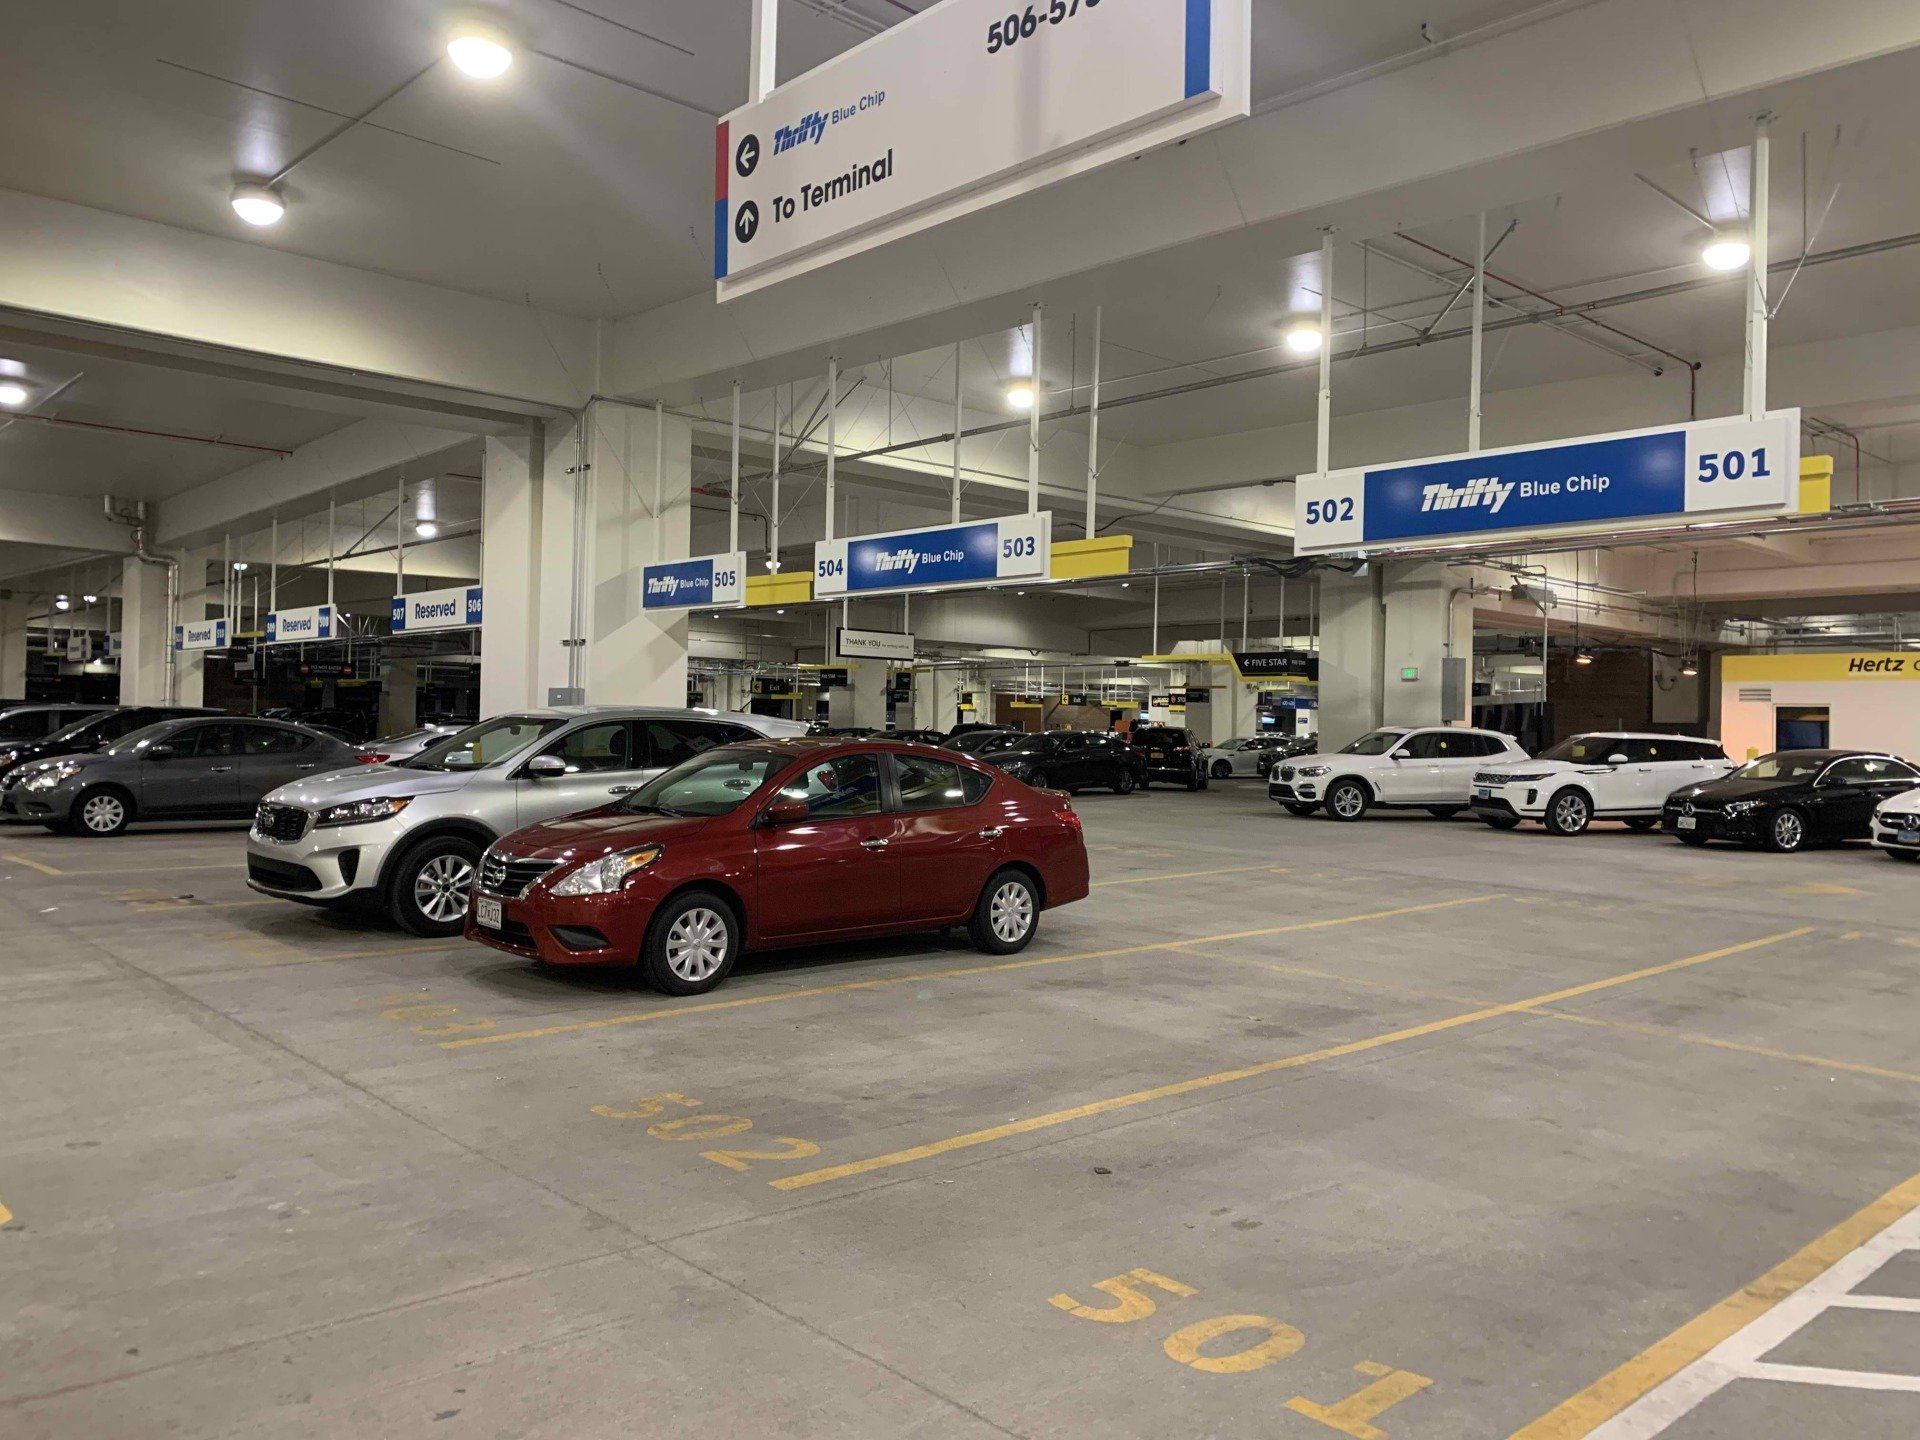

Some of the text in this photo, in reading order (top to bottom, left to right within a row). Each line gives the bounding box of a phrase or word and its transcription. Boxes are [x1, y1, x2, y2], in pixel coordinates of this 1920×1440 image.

[987, 0, 1101, 54] 506-57
[773, 91, 885, 155] Thrifty Blue Chip
[773, 148, 893, 223] To Terminal
[1698, 448, 1770, 483] 501
[1420, 474, 1610, 514] Thrifty Blue Chip
[1306, 497, 1354, 525] 502
[1002, 536, 1035, 558] 503
[818, 558, 844, 577] 504
[875, 549, 964, 574] Thrifty Blue Chip
[648, 576, 709, 596] Thrifty Blue Chip
[714, 570, 736, 587] 505
[392, 607, 404, 620] 507
[414, 598, 456, 619] Reserved
[467, 599, 482, 613] 506
[282, 616, 312, 632] Reserved
[188, 628, 210, 642] Reserved
[845, 638, 867, 646] THANK
[867, 639, 881, 647] YOU
[1251, 658, 1267, 667] FIVE
[1268, 658, 1288, 666] STAR
[1848, 657, 1905, 672] Hertz
[590, 1091, 821, 1171] 502
[1047, 1267, 1434, 1440] 501
